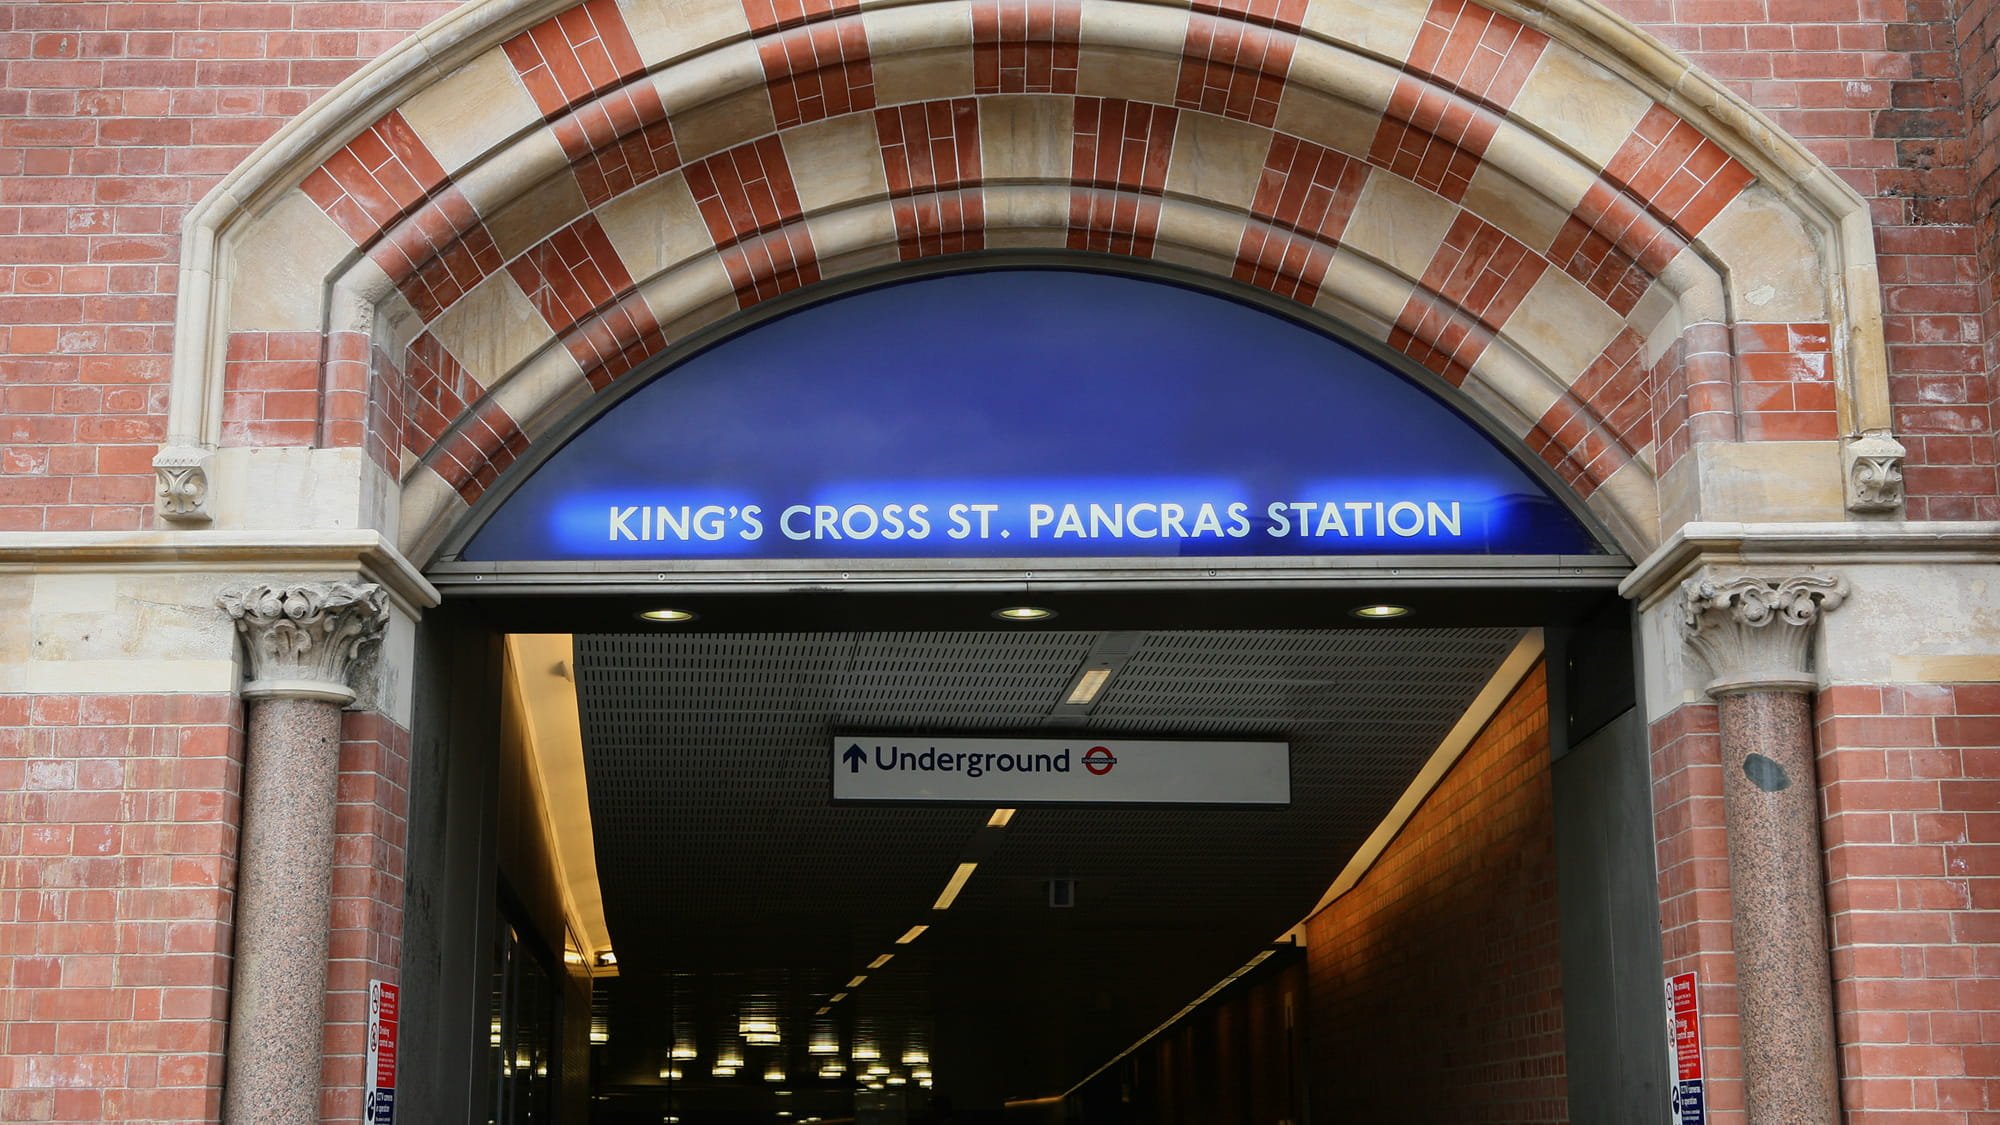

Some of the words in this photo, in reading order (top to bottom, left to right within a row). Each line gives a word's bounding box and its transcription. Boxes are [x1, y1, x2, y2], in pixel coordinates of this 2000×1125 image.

[609, 504, 763, 541] KING'S
[780, 503, 930, 540] CROSS
[947, 503, 1010, 539] ST.
[1029, 502, 1250, 539] PANCRAS
[1267, 500, 1461, 538] STATION
[875, 746, 1070, 778] Underground
